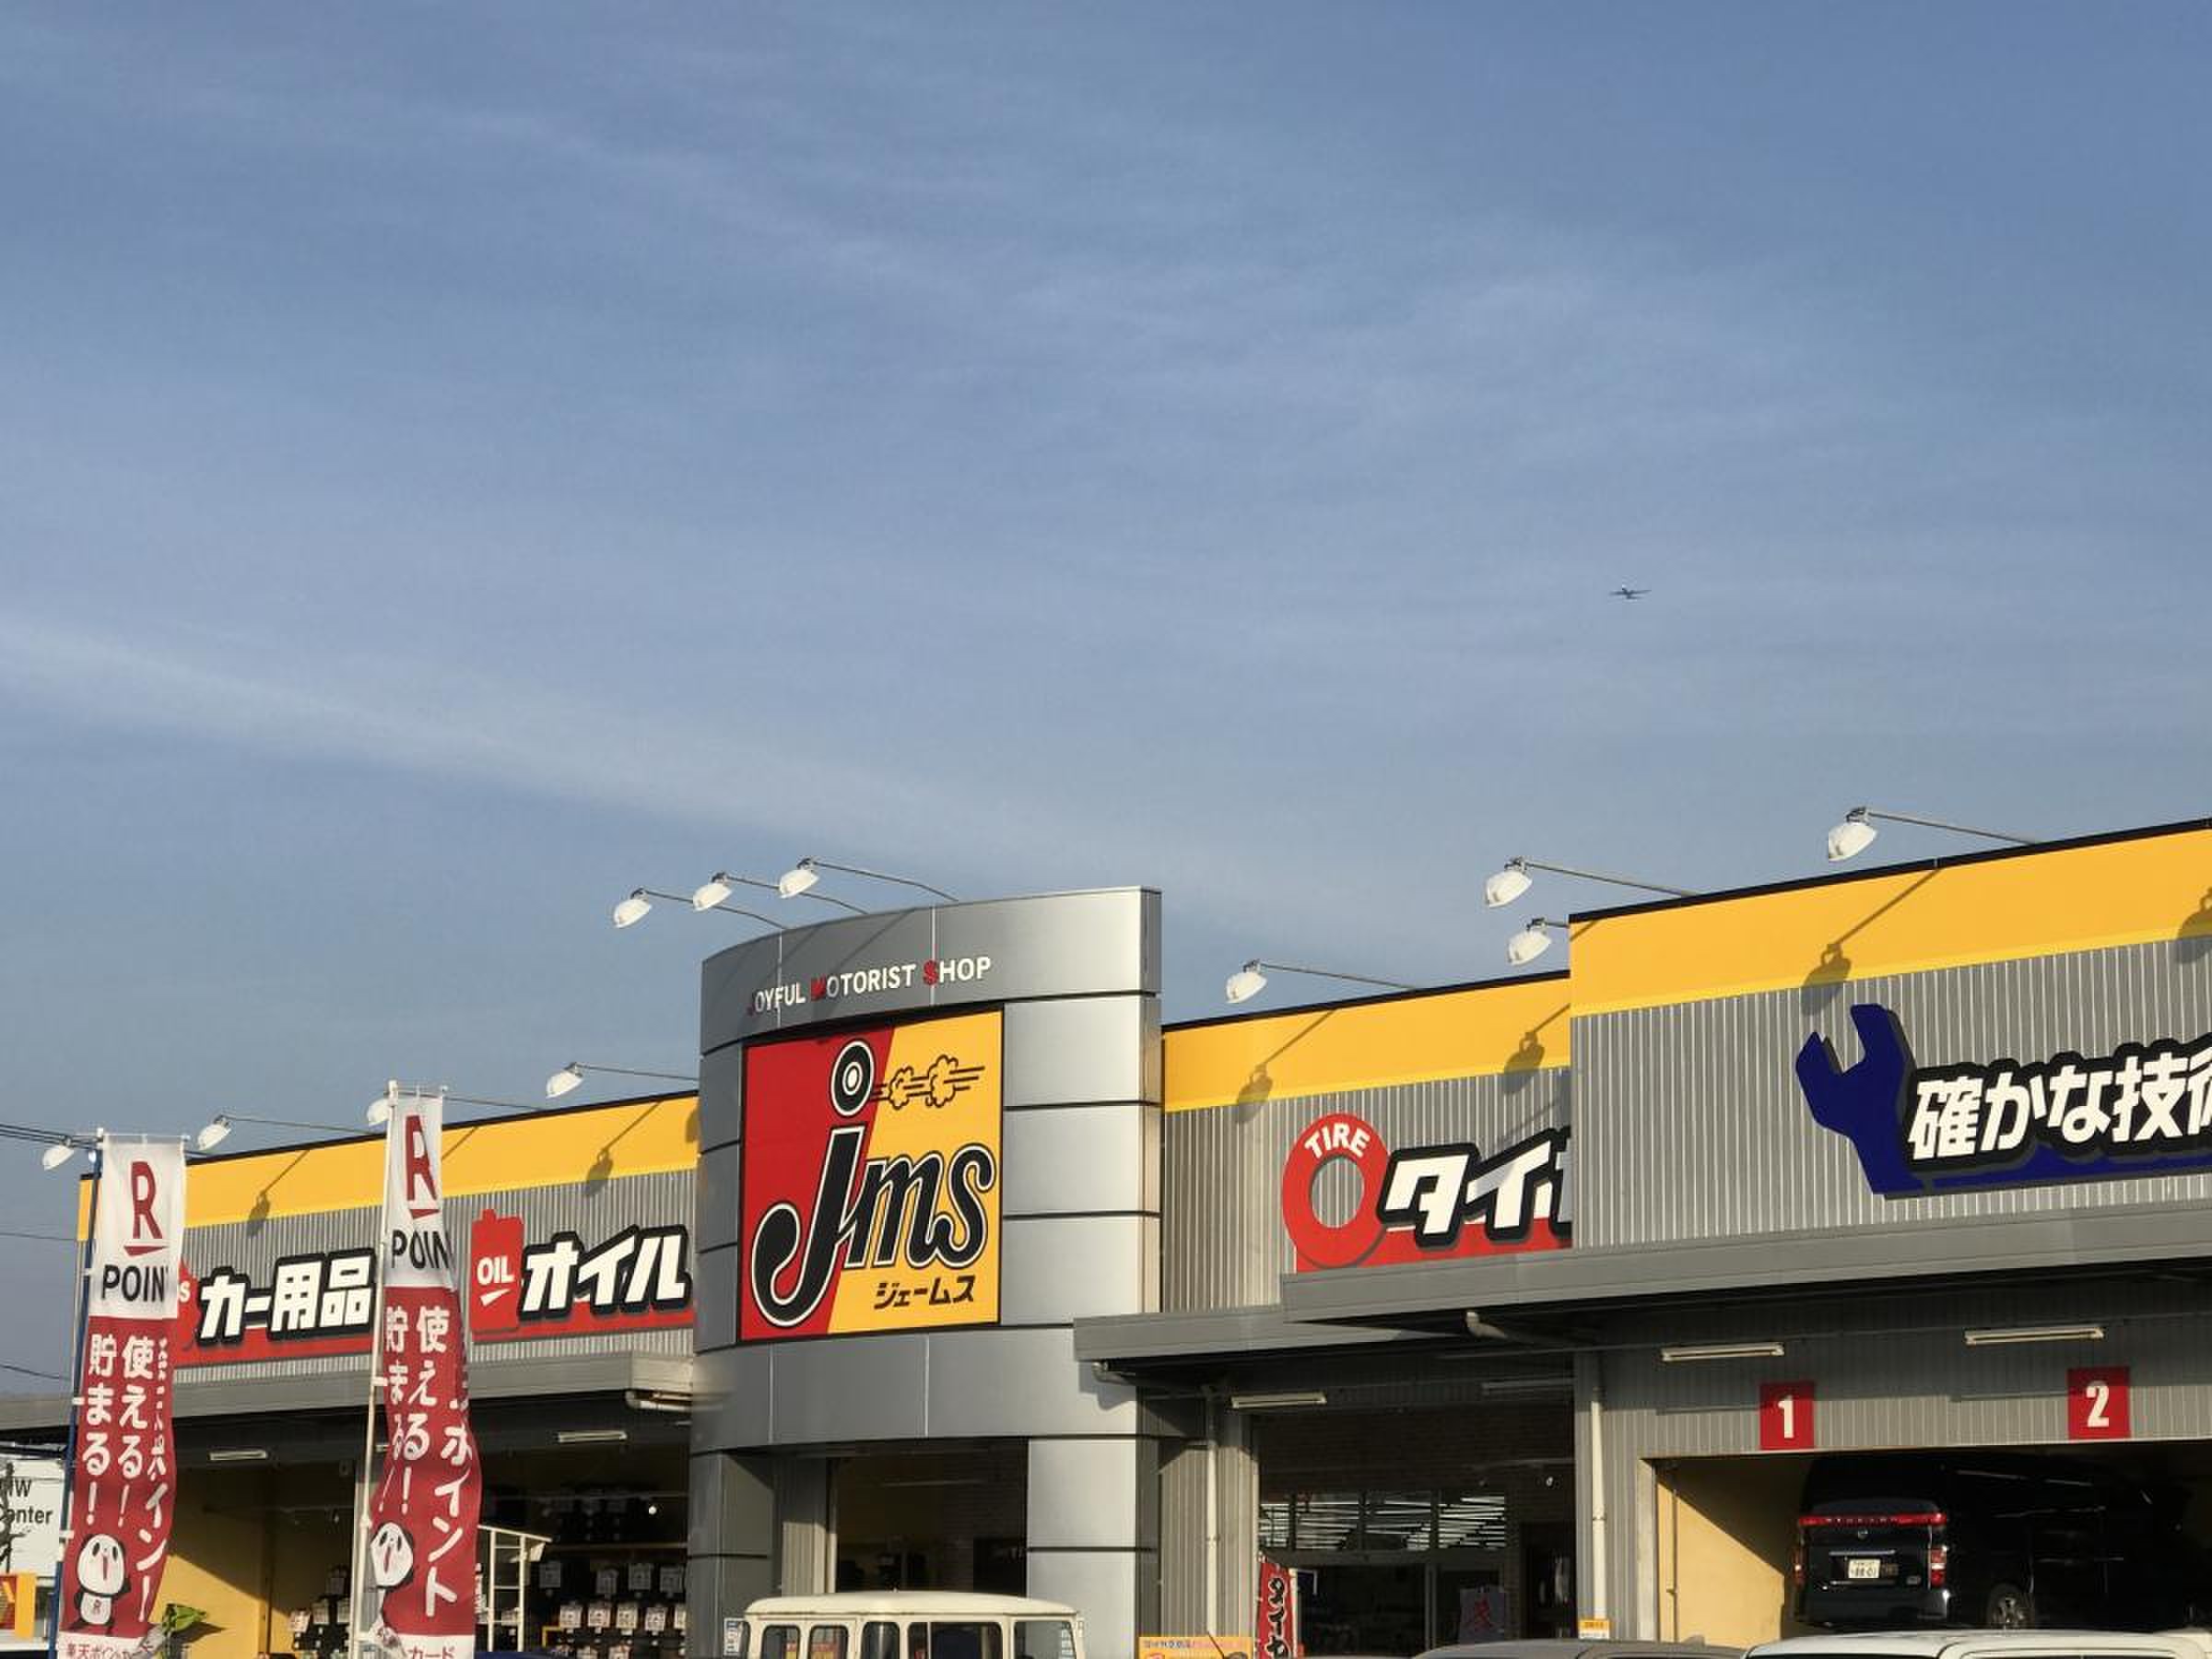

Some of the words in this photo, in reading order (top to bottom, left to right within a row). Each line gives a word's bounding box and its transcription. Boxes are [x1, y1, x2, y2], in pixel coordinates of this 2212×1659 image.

[810, 964, 916, 1004] MOTORIST
[924, 957, 992, 986] SHOP
[406, 1116, 437, 1201] R
[1304, 1123, 1371, 1159] TIRE
[131, 1161, 163, 1239] R
[391, 1230, 454, 1269] POIN
[477, 1257, 514, 1286] OIL
[102, 1265, 170, 1302] POIN
[200, 1255, 372, 1339] カー用品
[523, 1235, 686, 1312] オイル
[874, 1275, 975, 1310] ジェームス
[1778, 1394, 1794, 1439] 1
[2086, 1380, 2110, 1428] 2
[82, 1334, 117, 1525] 貯まる!
[117, 1335, 155, 1527] 使える!
[4, 1506, 53, 1524] enter
